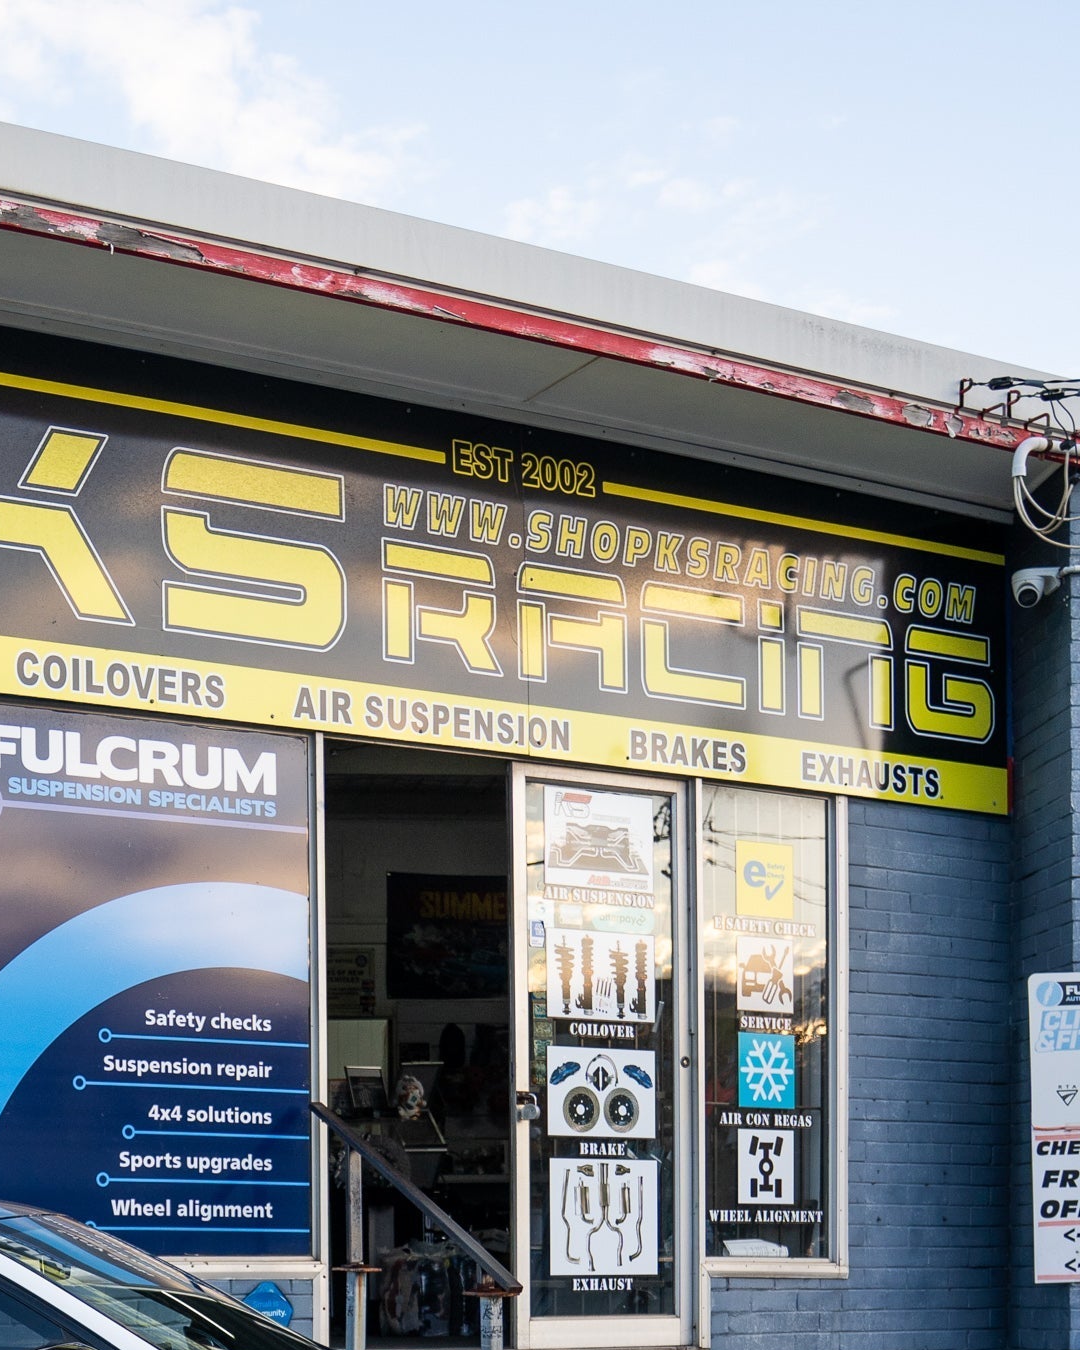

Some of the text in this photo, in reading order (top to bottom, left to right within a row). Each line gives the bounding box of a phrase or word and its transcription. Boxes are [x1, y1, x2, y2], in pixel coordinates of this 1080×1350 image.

[451, 439, 597, 498] EST 2002
[382, 483, 977, 625] WWW.SHOPKSRACING.COM
[16, 650, 226, 709] COILOVERS
[293, 685, 571, 753] AIR SUSPENSION
[629, 727, 748, 775] BRAKES
[801, 751, 941, 799] EXHAUSTS
[8, 776, 277, 818] SUSPENSION SPECIALISTS
[544, 885, 655, 909] AIR SUSPENSION
[713, 916, 816, 937] E SAFETY CHECK
[145, 1008, 272, 1033] Safety checks
[570, 1022, 634, 1038] COILOVER
[740, 1016, 792, 1030] SERVICE
[103, 1055, 272, 1083] Suspension repair
[148, 1105, 272, 1126] 4x4 solutions
[720, 1112, 812, 1127] AIR CON REGAS
[580, 1142, 625, 1156] BRAKE
[118, 1151, 273, 1177] Sports upgrades
[111, 1199, 273, 1225] Wheel alignment
[709, 1209, 823, 1223] WHEEL ALIGNMENT
[573, 1277, 634, 1291] EXHAUST
